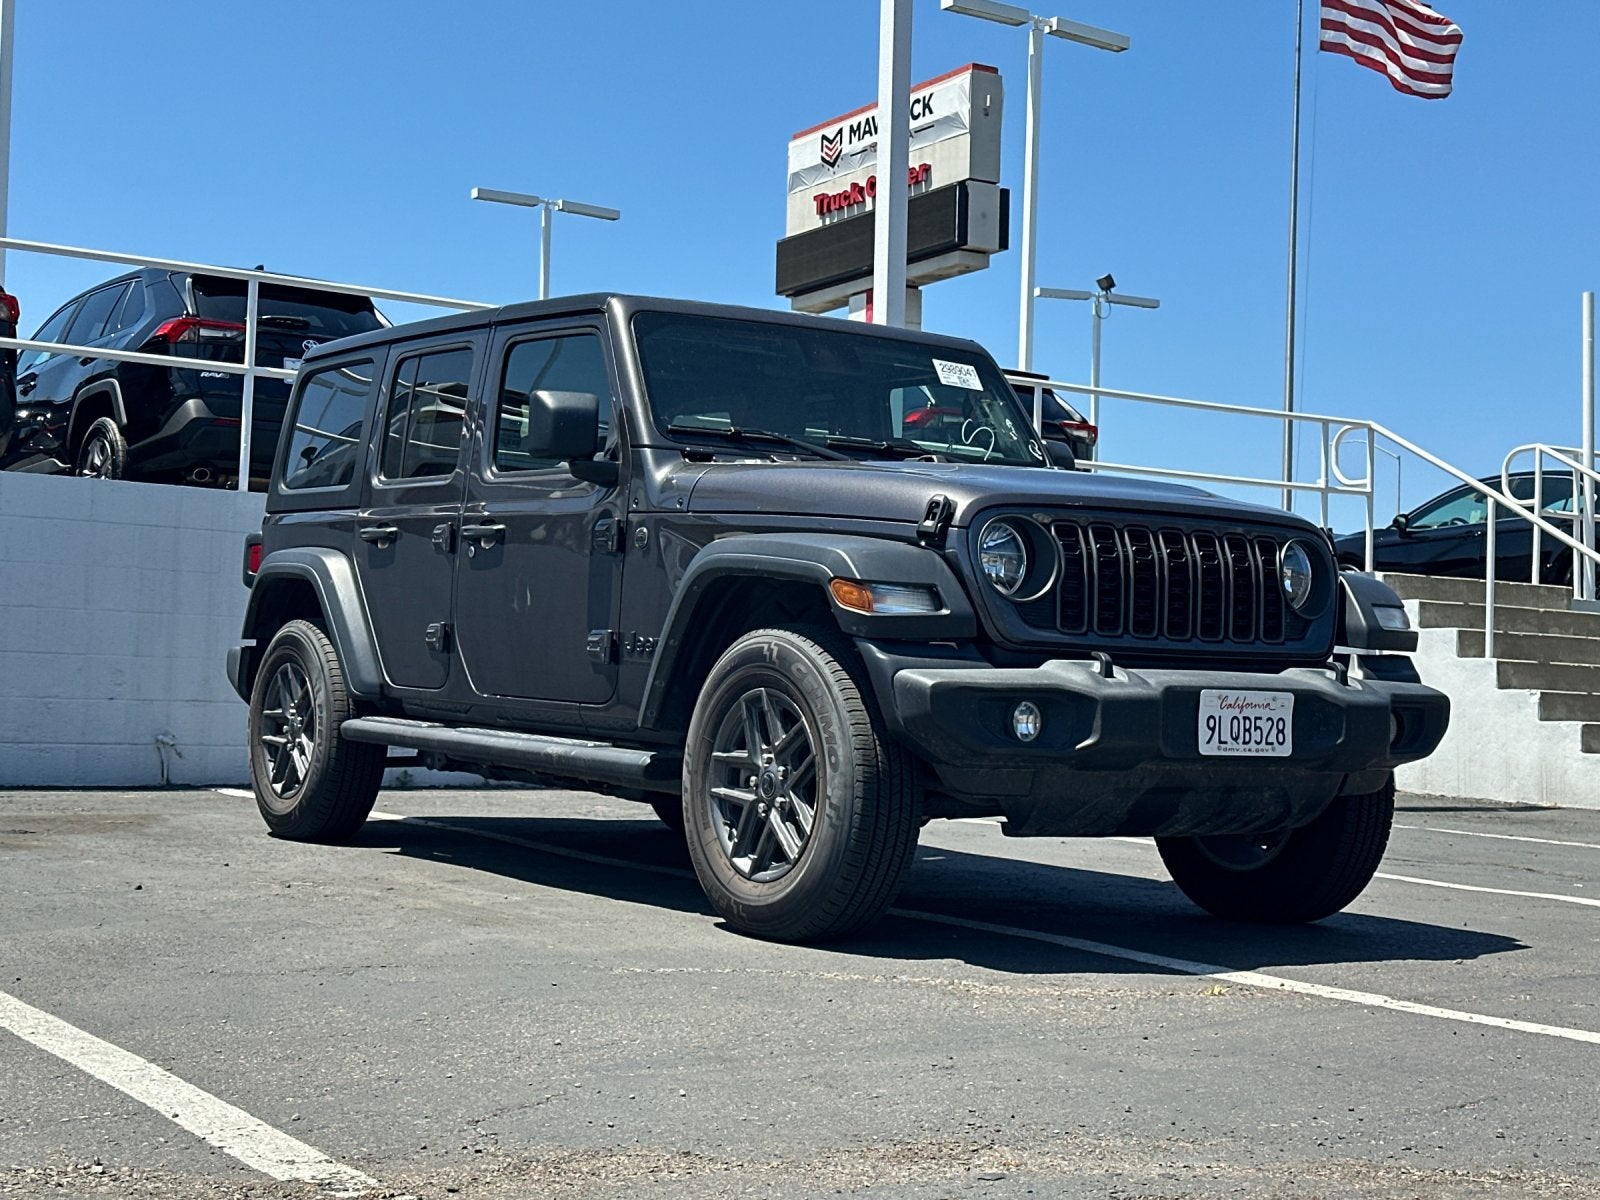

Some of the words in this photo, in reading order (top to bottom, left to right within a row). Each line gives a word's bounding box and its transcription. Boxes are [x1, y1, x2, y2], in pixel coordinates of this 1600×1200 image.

[849, 92, 934, 145] MAVCK
[813, 182, 865, 215] Truck
[865, 163, 932, 198] Cer
[939, 362, 977, 378] 2989041
[1220, 695, 1276, 714] California
[1205, 714, 1286, 746] 9LQB528
